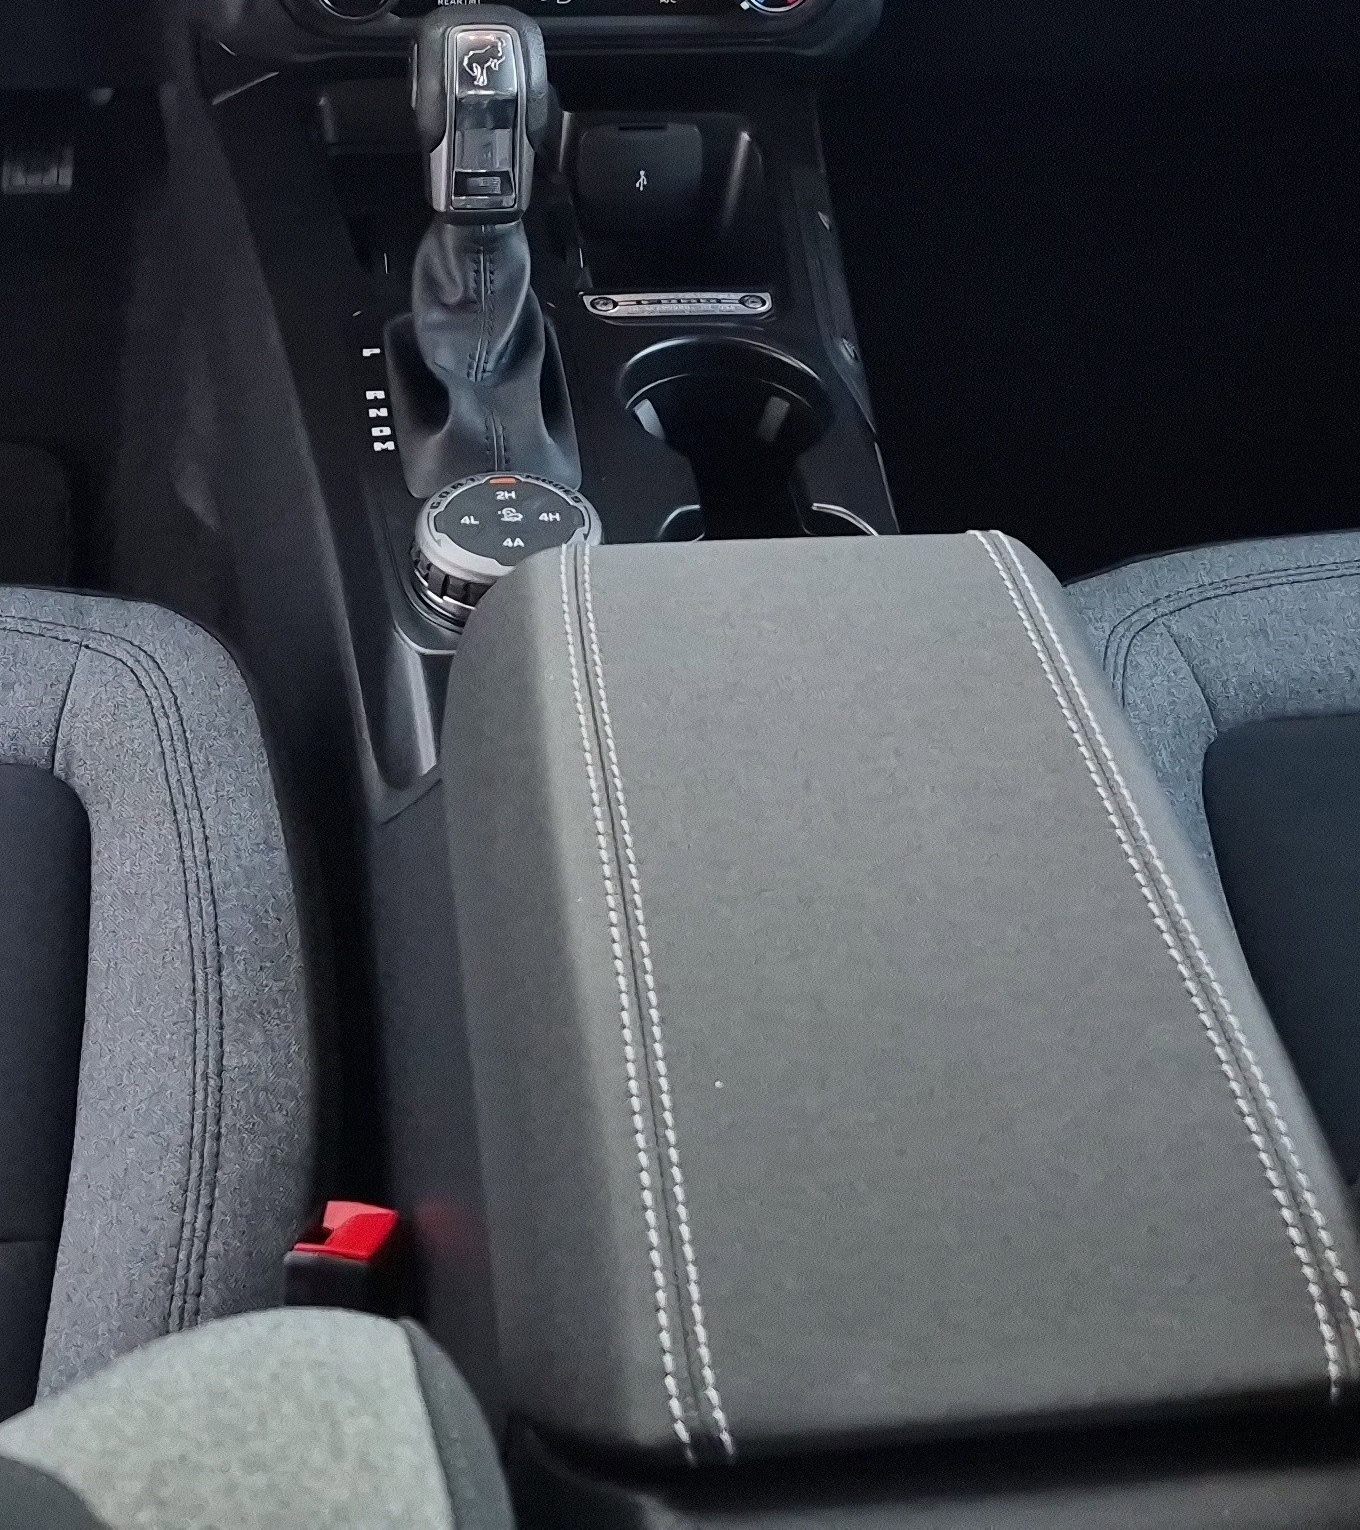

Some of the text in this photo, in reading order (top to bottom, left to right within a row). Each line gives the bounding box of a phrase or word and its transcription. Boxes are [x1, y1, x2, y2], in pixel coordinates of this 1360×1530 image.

[368, 407, 388, 418] N
[373, 440, 396, 452] M
[495, 490, 517, 500] 2H
[460, 515, 480, 525] 4L
[538, 512, 561, 522] 4H
[502, 537, 525, 548] 4A
